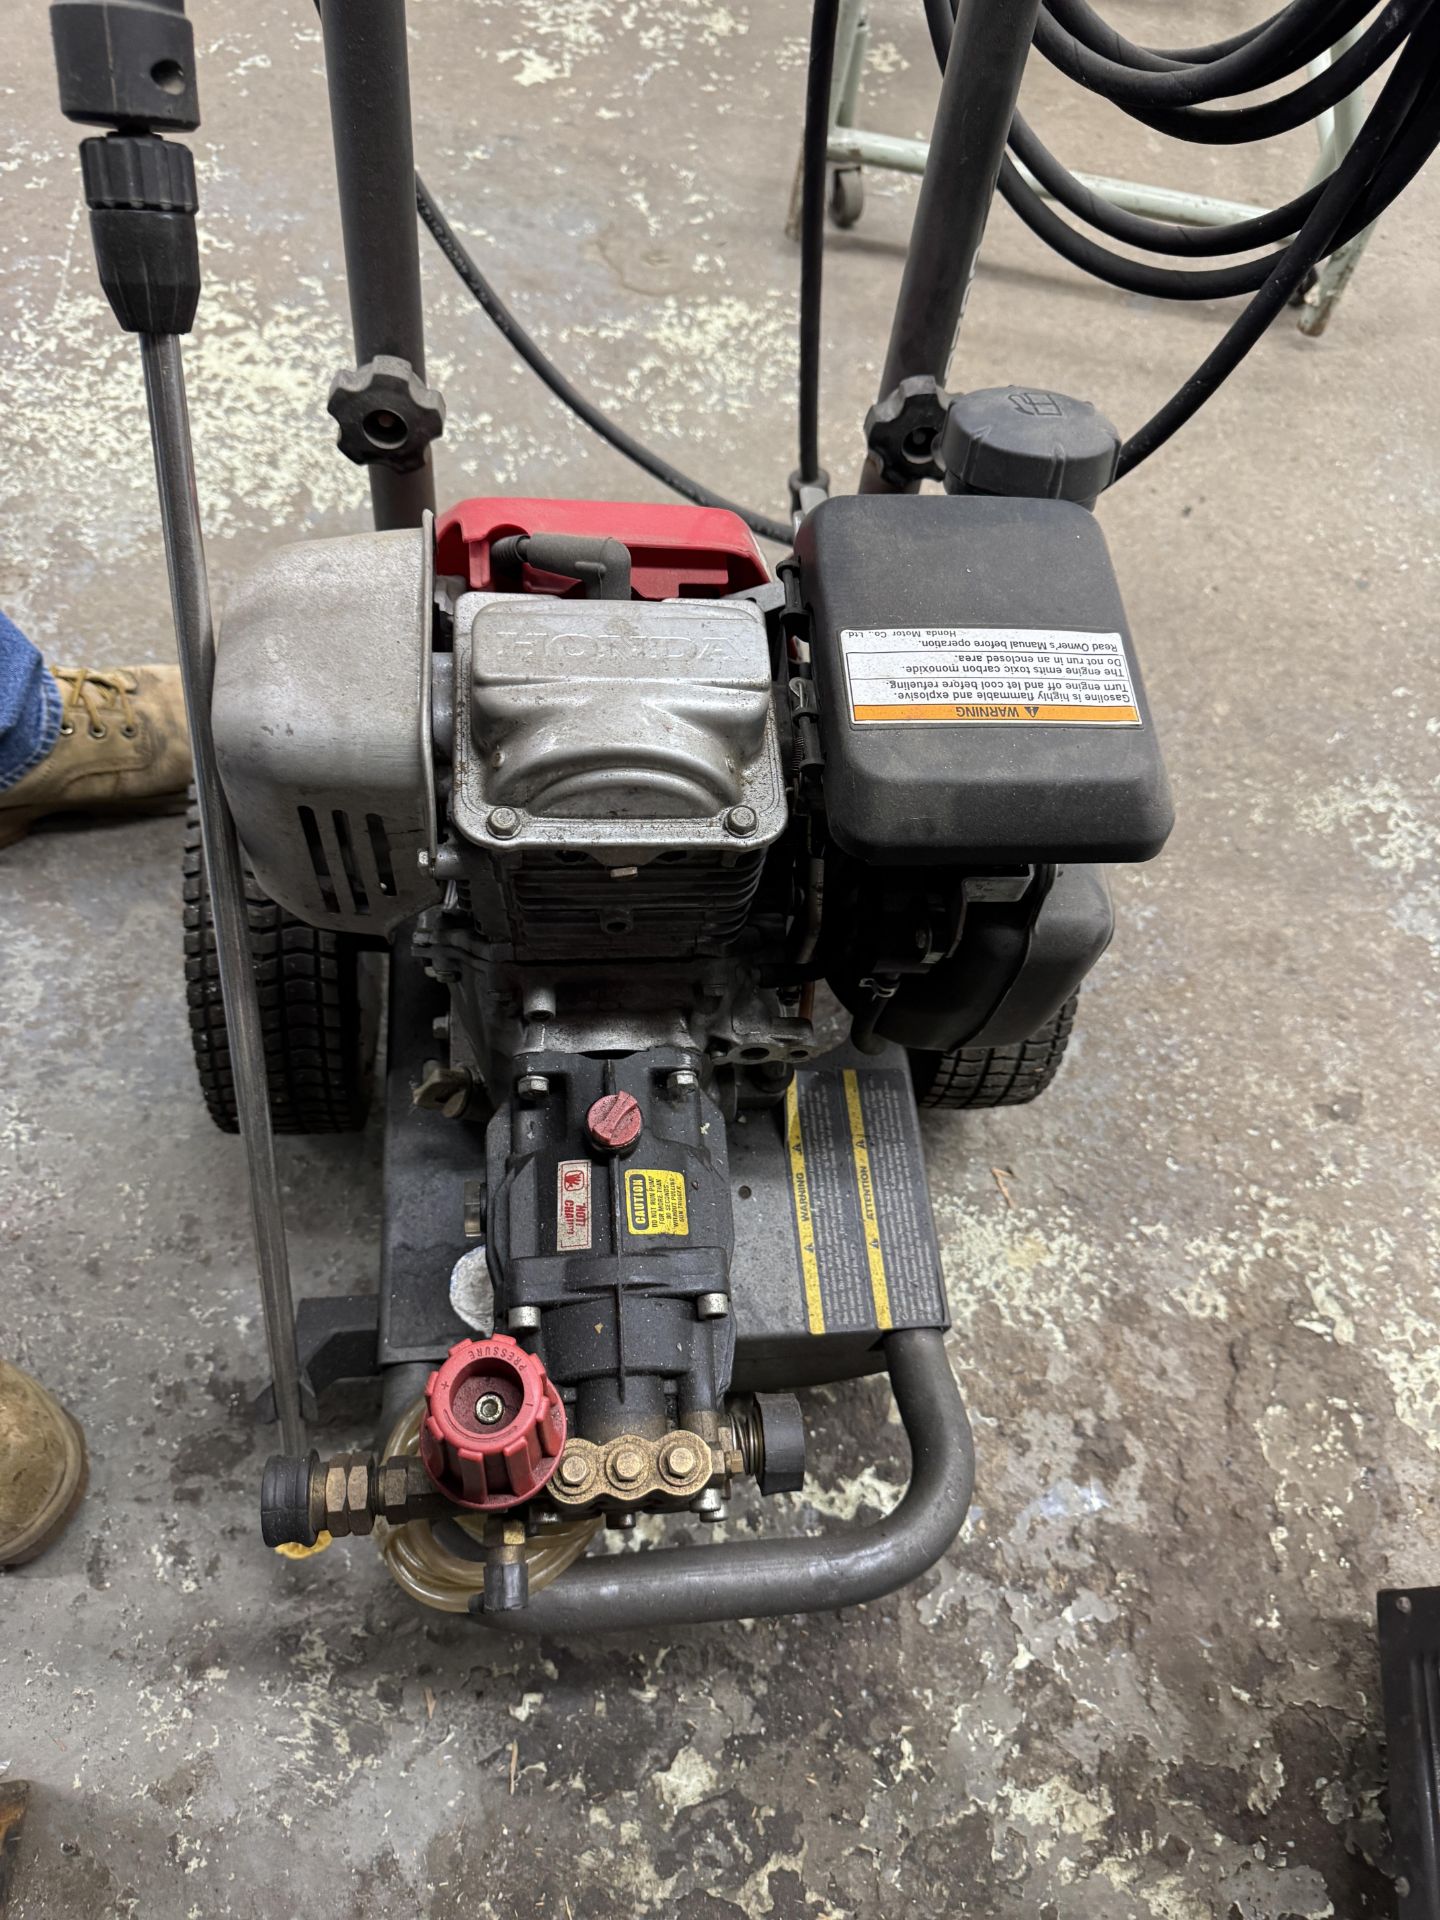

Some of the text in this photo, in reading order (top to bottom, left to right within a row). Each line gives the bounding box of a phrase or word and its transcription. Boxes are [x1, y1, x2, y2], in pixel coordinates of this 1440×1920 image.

[496, 631, 749, 660] HONDA
[919, 639, 1117, 652] Read Owner's Manual before operation.
[987, 655, 1033, 664] enclosed
[1038, 656, 1049, 664] an
[1054, 657, 1063, 665] in
[902, 665, 1124, 677] The engine emits toxic carbon monoxide.
[886, 681, 1128, 692] Turn engine off and let cool before refueling.
[894, 690, 1130, 702] Gasoline is highly flammable and explosive.
[956, 706, 1019, 717] WARNING
[798, 1172, 810, 1222] WARNING
[860, 1165, 875, 1221] ATTENTION
[633, 1180, 646, 1224] CAUTION
[468, 1346, 527, 1371] PRESSURE
